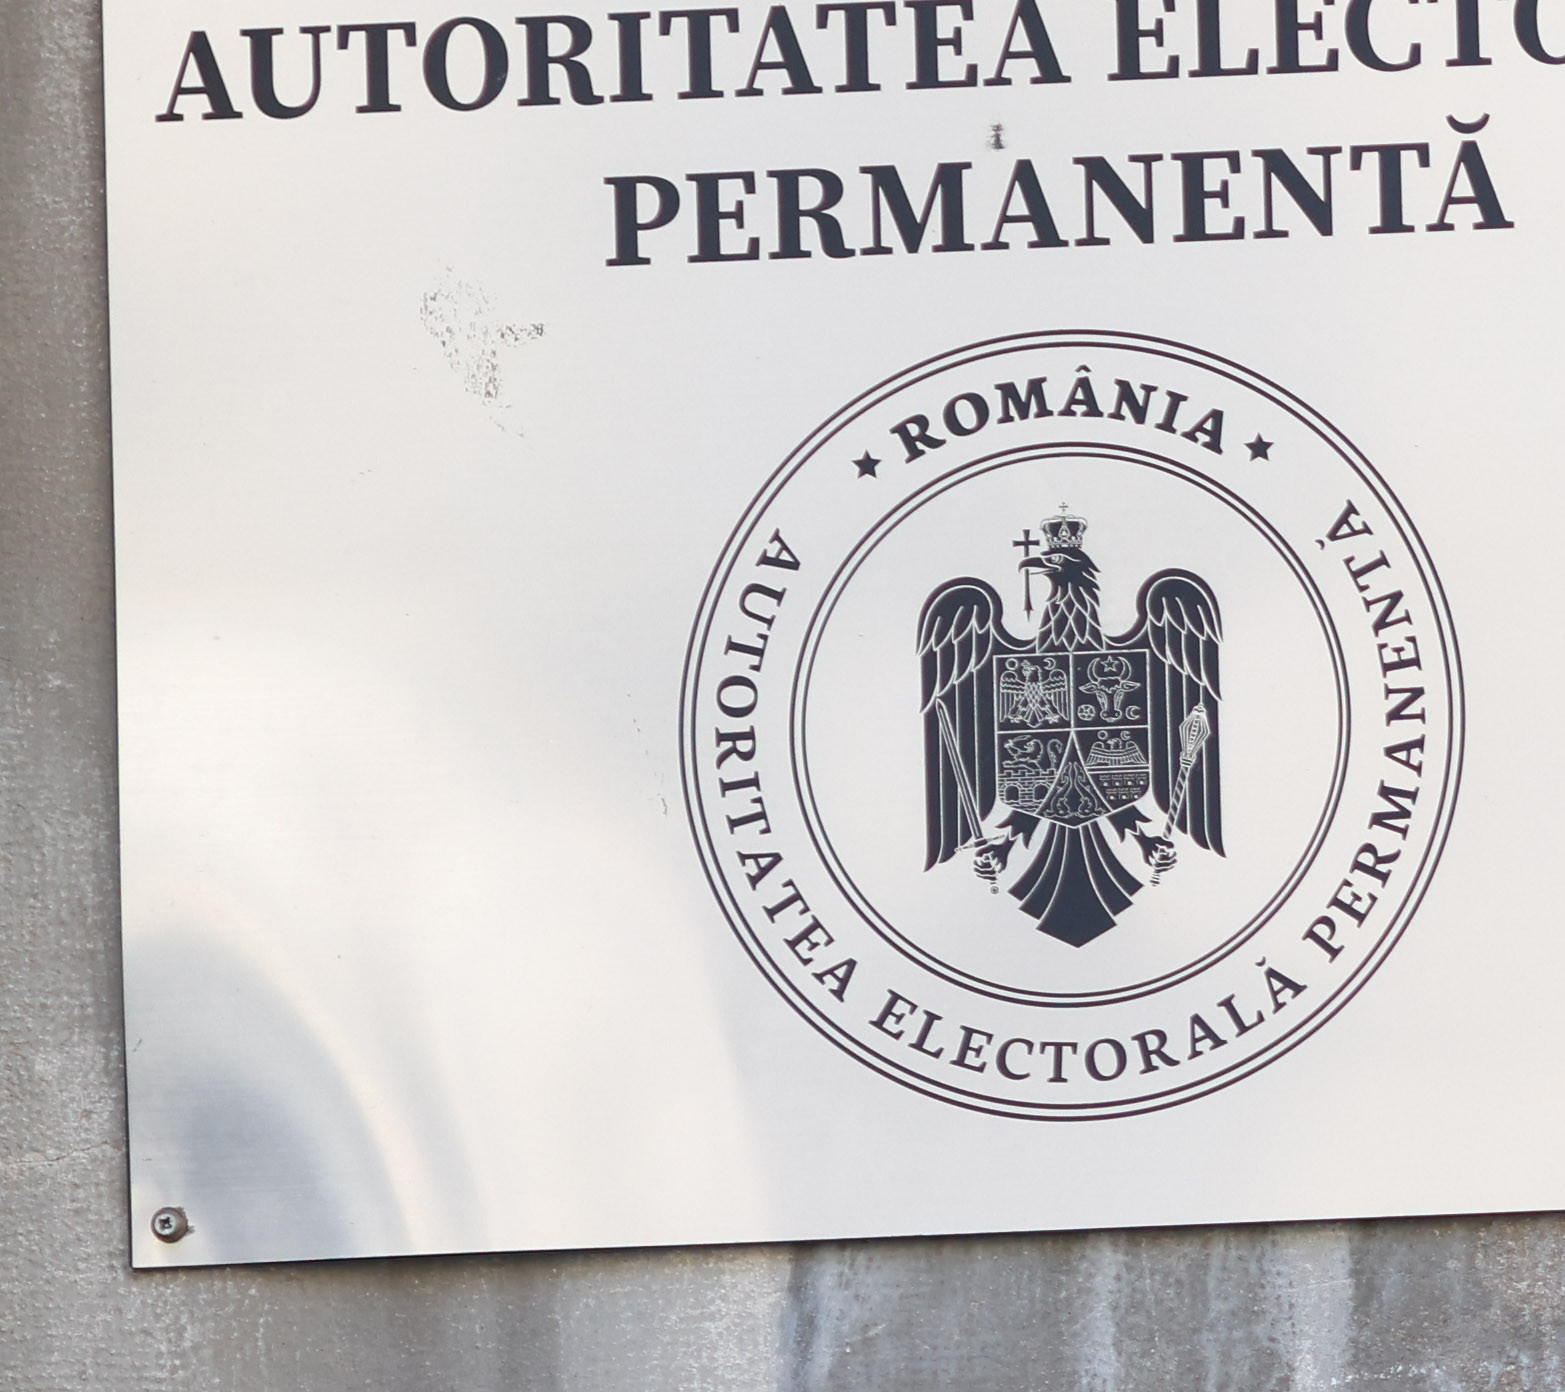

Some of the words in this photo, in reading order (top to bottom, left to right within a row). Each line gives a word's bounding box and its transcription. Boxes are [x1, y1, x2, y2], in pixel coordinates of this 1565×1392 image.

[603, 113, 1515, 268] PERMANENTĂ
[889, 364, 1226, 465] ROMÂNIA
[713, 527, 858, 1003] AUTORITATEA
[868, 955, 1307, 1084] ELECTORALĂ
[1301, 497, 1428, 964] PERMANENTĂ
